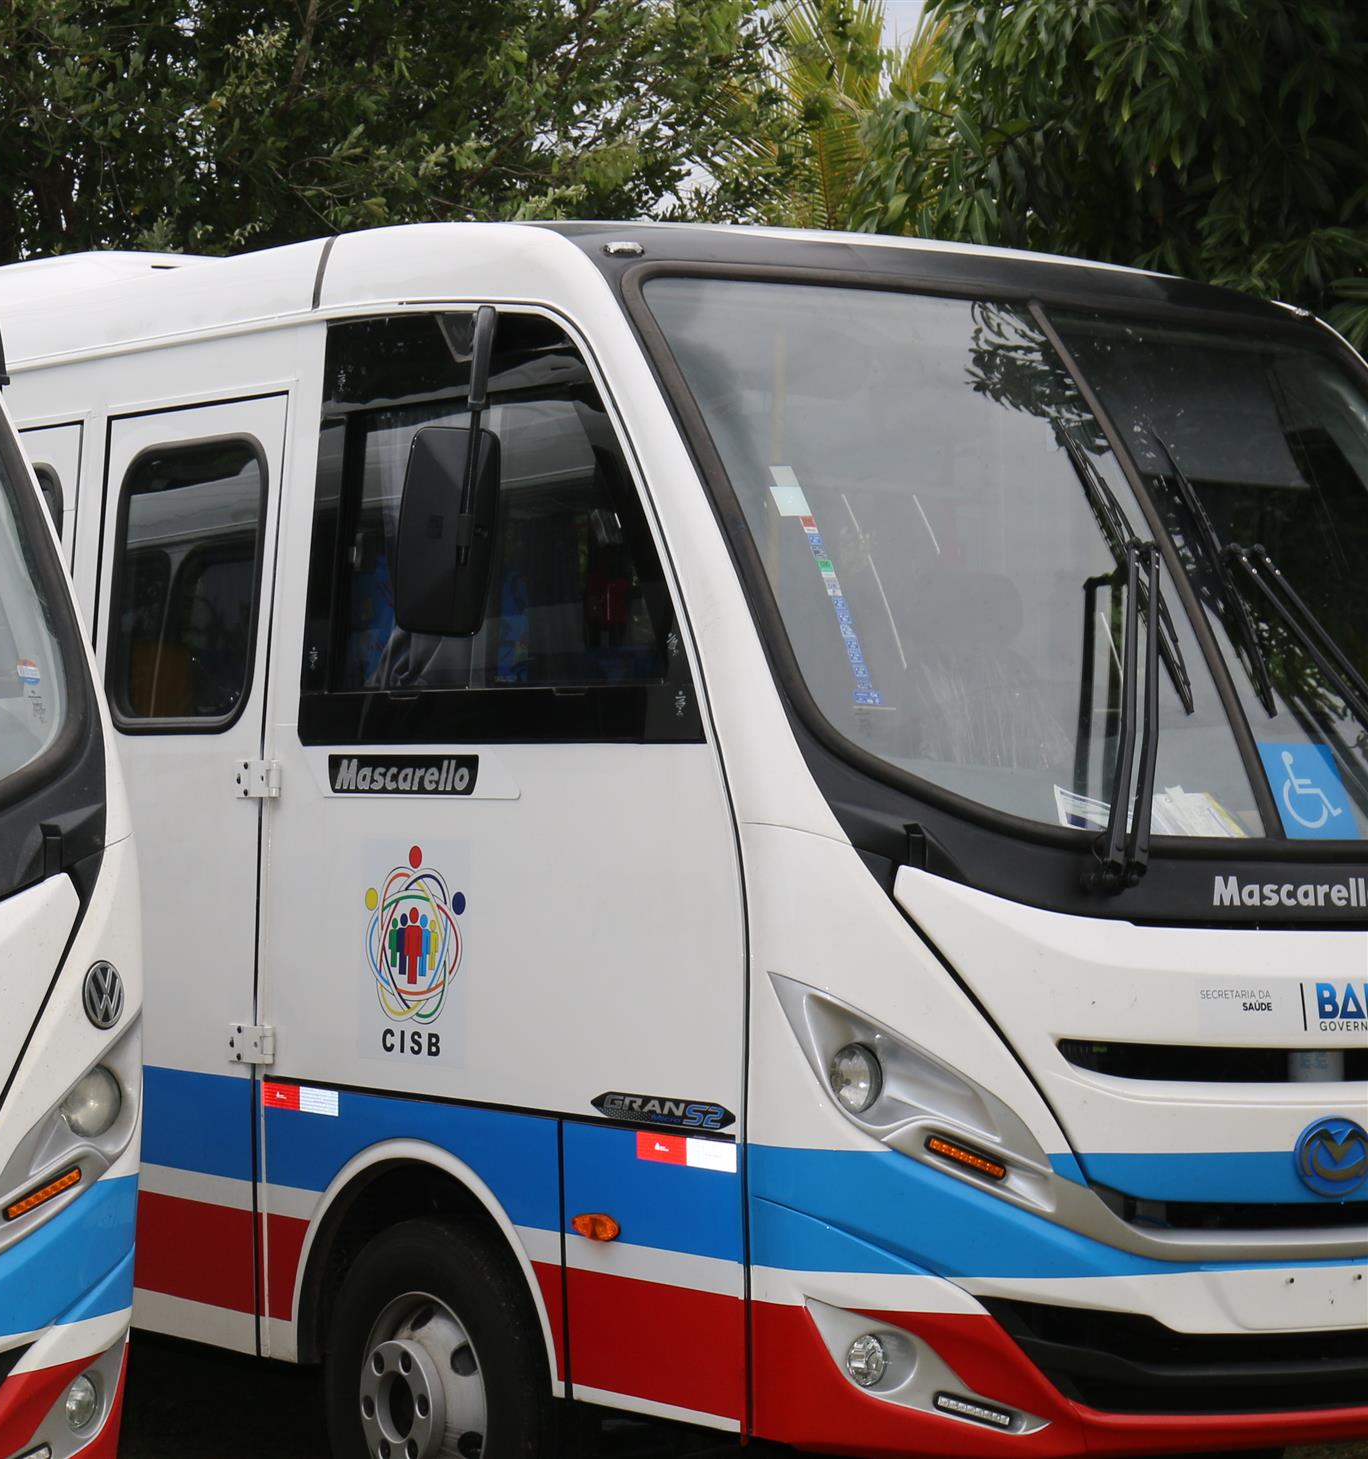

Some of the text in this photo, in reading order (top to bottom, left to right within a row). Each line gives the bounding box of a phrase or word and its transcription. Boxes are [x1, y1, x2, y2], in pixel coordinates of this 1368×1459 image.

[335, 758, 469, 791] Mascarello
[1213, 876, 1368, 907] Mascarell
[1200, 989, 1272, 1000] SECRETARIA DA
[1242, 1001, 1272, 1011] SAÚDE
[1316, 982, 1368, 1020] BA
[381, 1028, 441, 1057] CISB
[603, 1094, 724, 1128] GRAN S2
